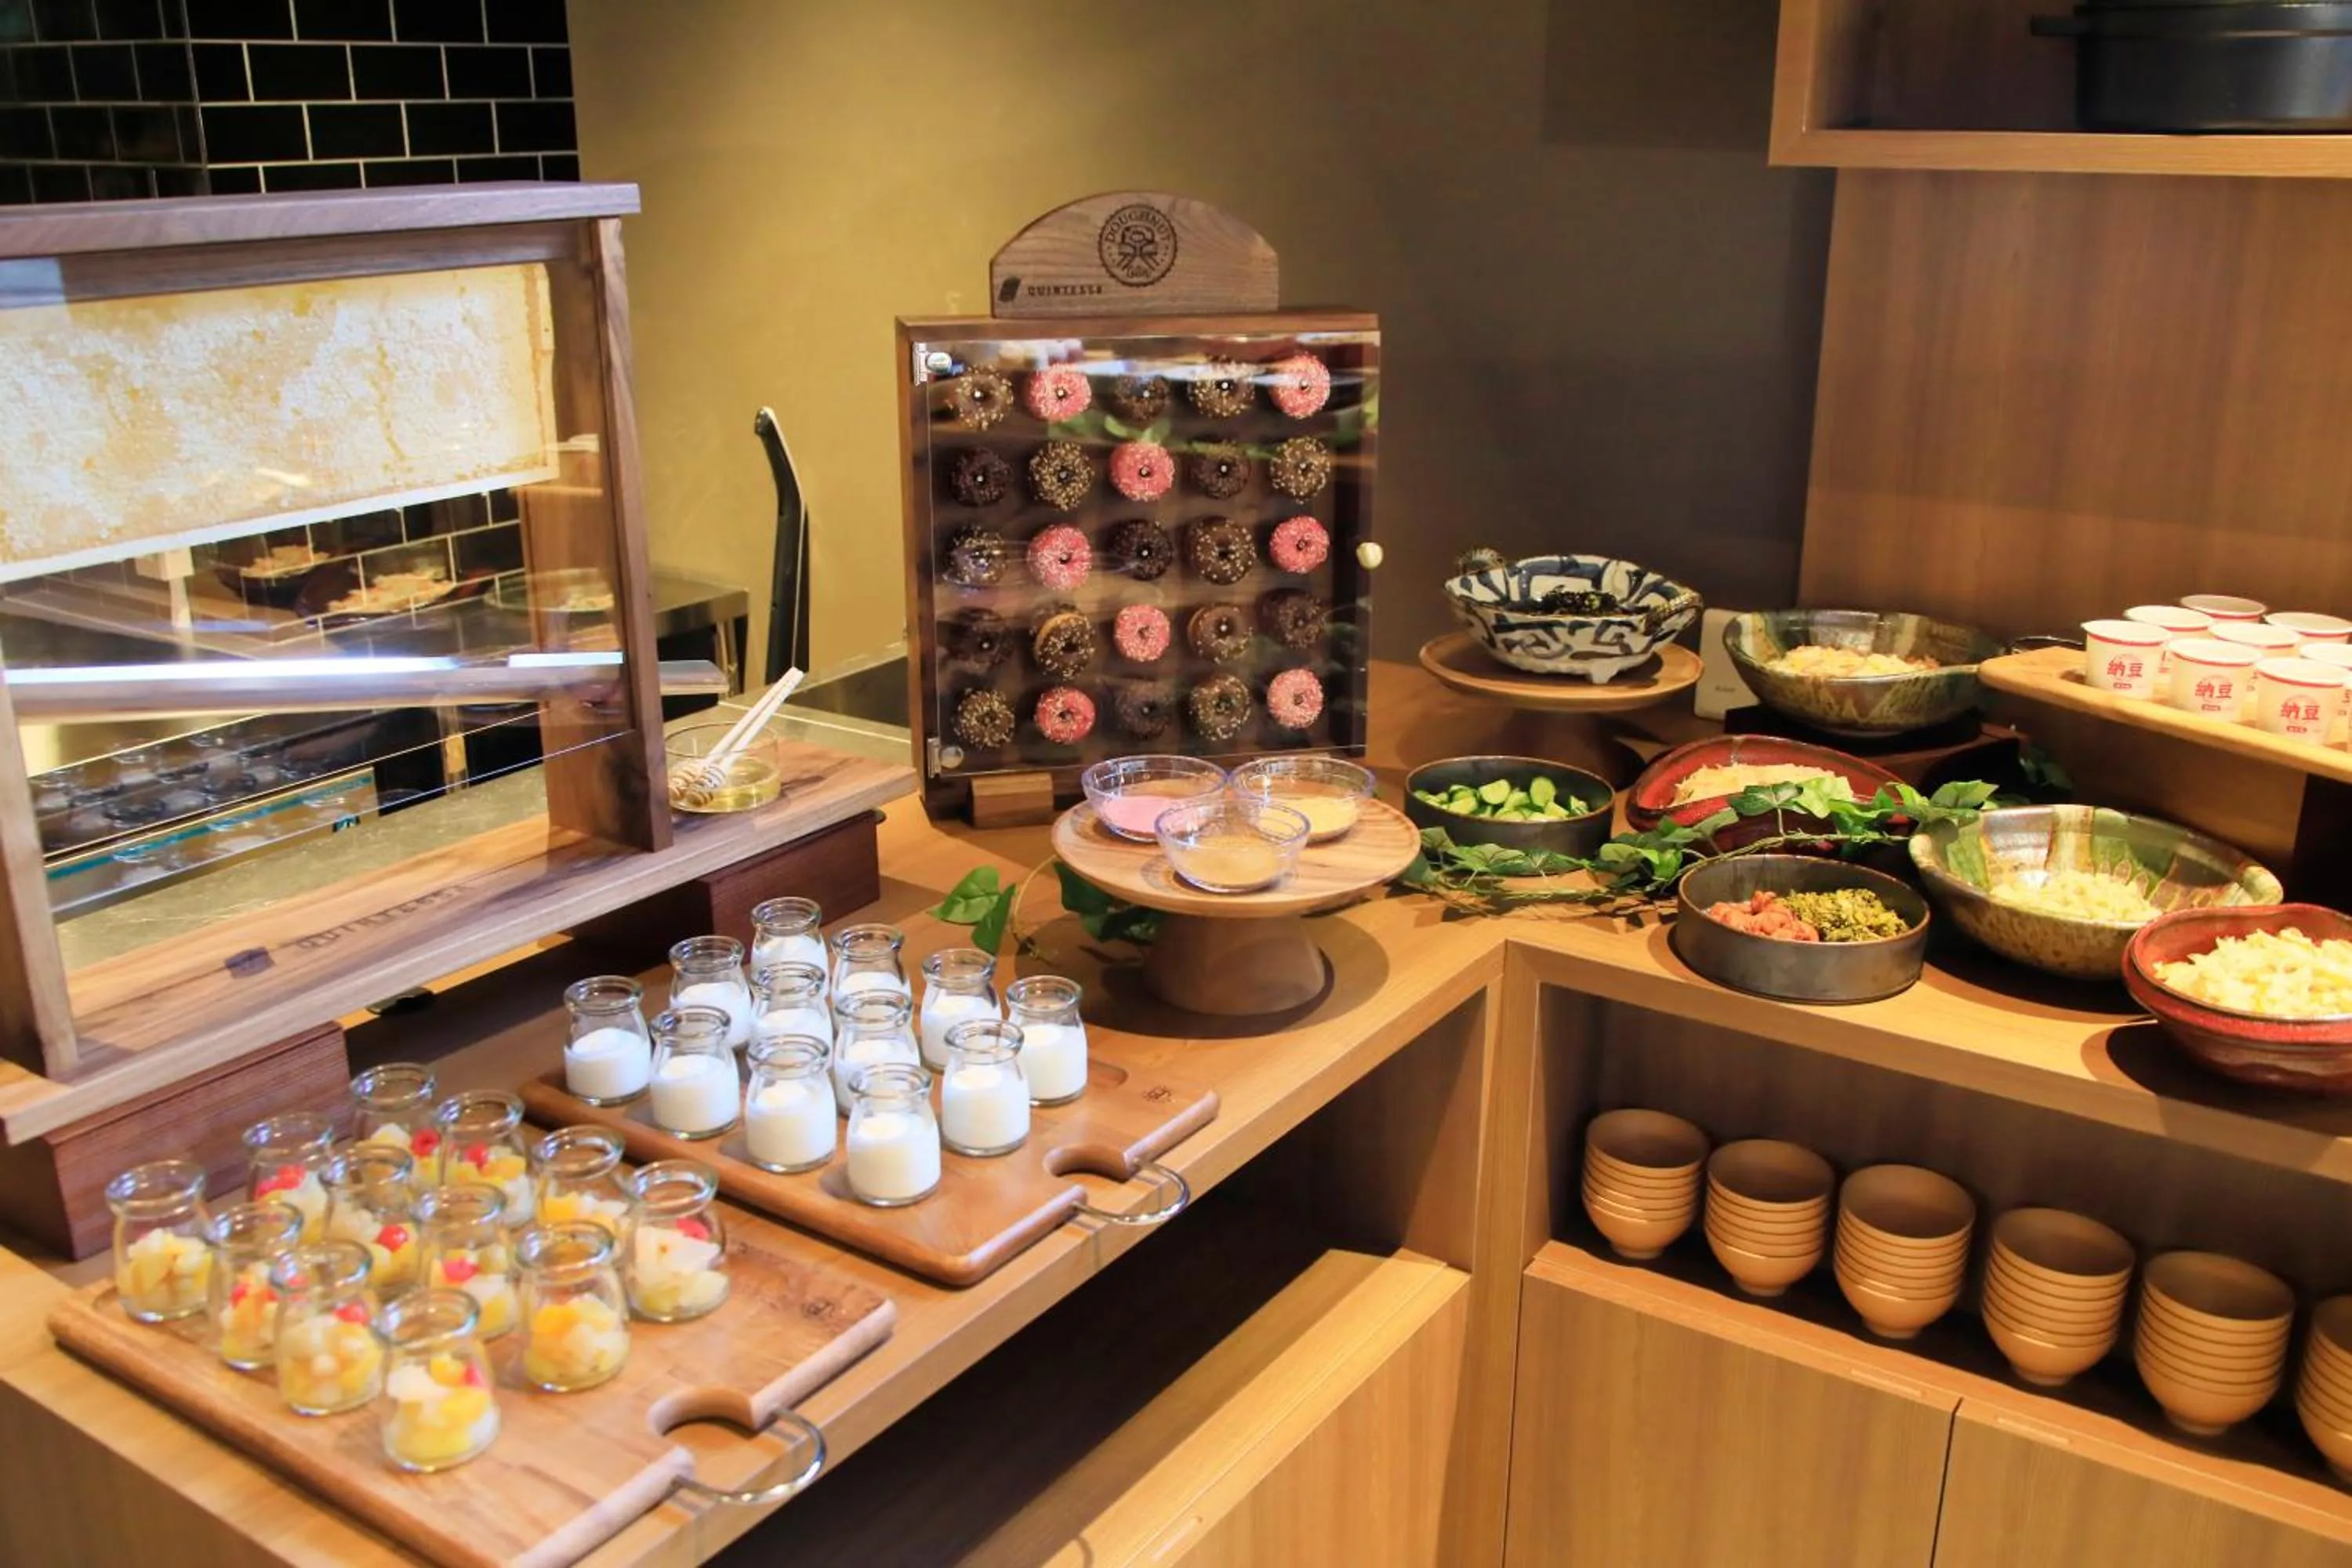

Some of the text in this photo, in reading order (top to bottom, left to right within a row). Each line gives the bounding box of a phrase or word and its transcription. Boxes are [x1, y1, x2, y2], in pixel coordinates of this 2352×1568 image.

[1104, 210, 1171, 243] DOUGHNUT
[2107, 659, 2143, 678] 納豆
[2194, 681, 2233, 699] 納豆
[2280, 702, 2321, 720] 納豆
